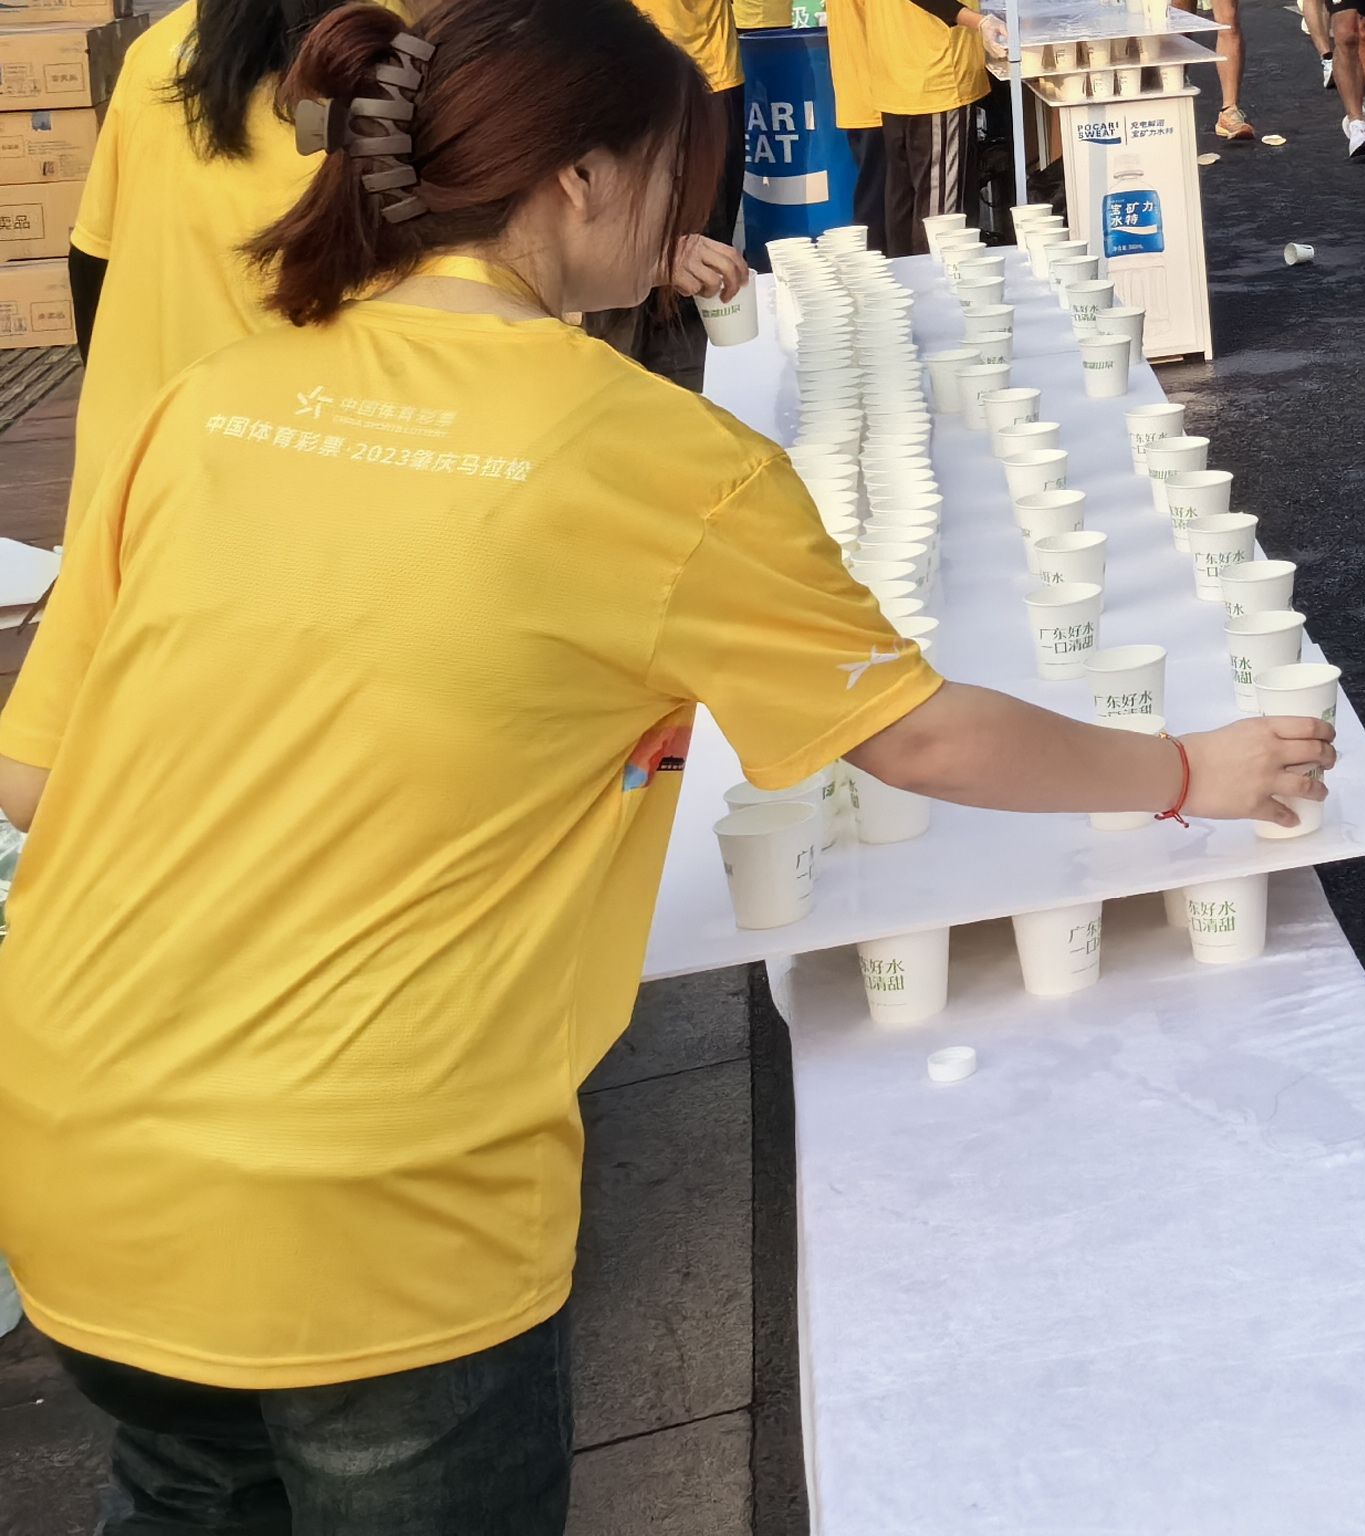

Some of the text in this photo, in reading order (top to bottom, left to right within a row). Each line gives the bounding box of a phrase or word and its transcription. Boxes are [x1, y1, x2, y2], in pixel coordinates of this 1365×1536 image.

[1077, 121, 1119, 132] POCARI
[1078, 129, 1115, 139] SWEAT
[1110, 201, 1154, 216] 宝矿力
[1111, 214, 1139, 226] 水特
[1039, 620, 1095, 641] 广东好水
[1040, 634, 1095, 654] 一口清甜
